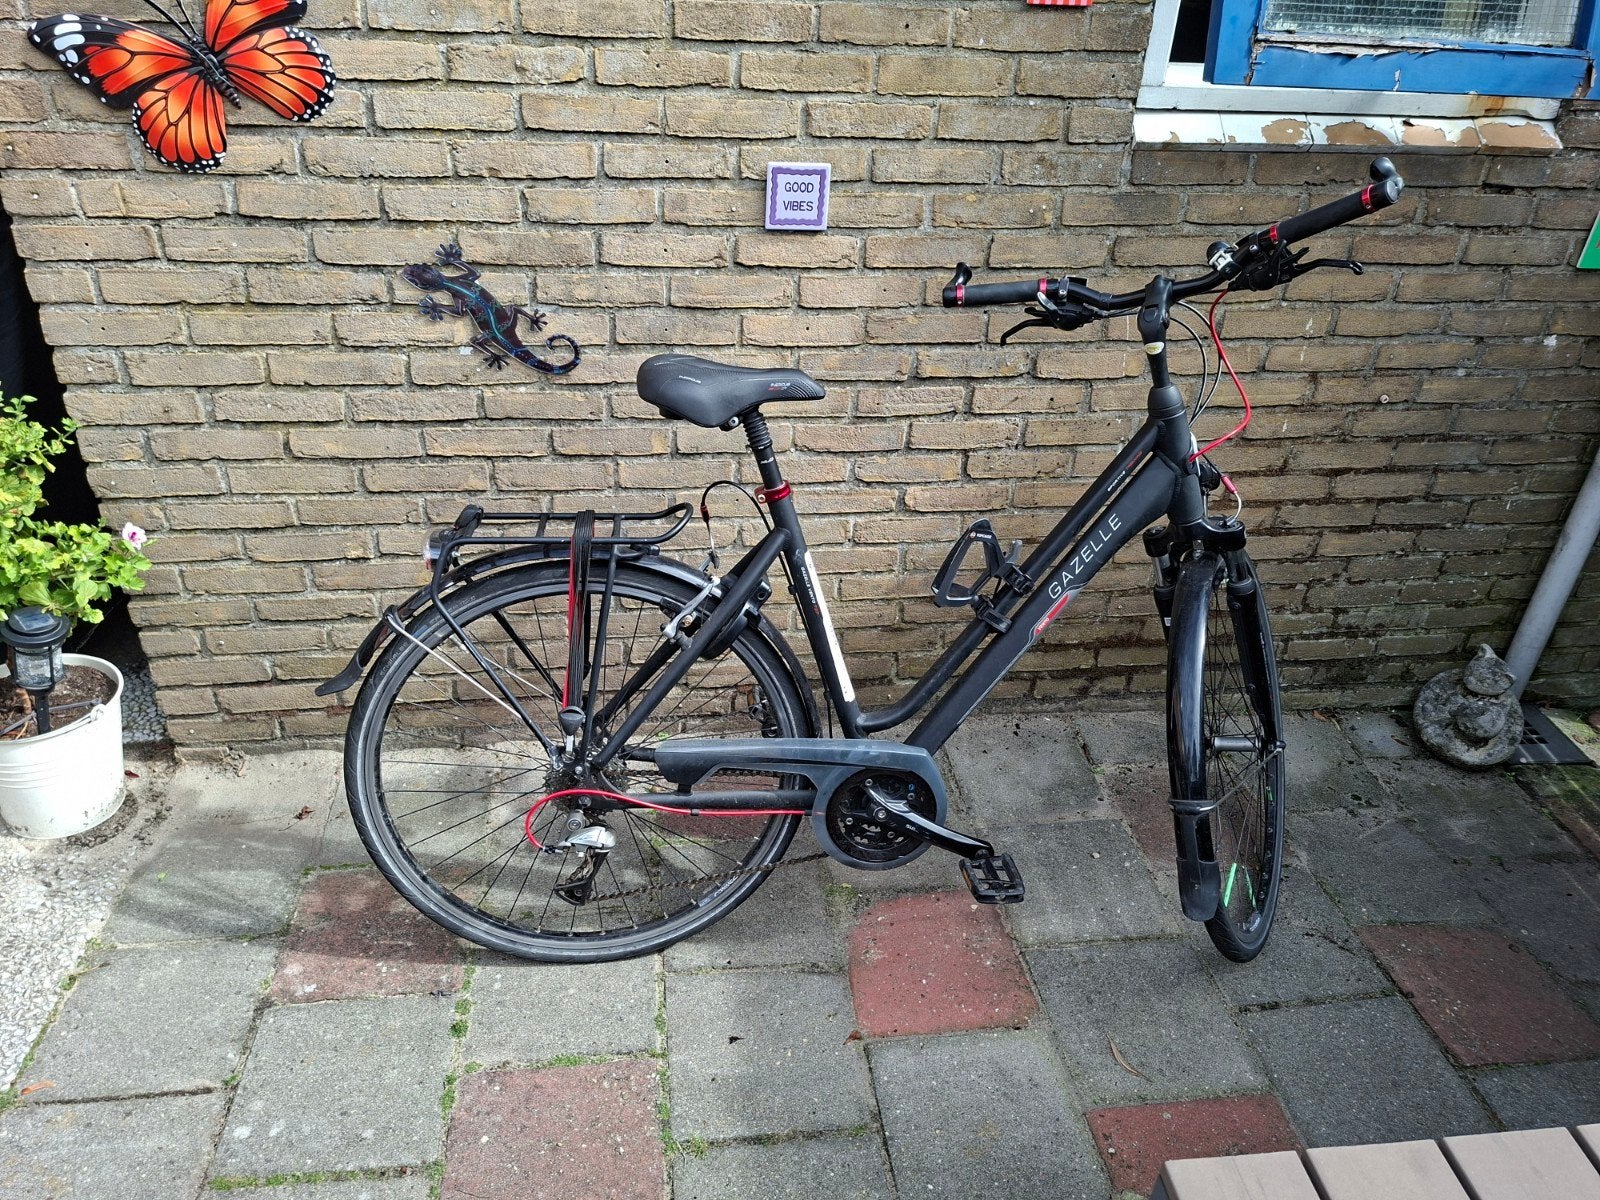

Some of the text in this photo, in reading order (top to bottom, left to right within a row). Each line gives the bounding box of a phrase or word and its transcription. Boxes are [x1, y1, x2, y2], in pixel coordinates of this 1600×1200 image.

[785, 182, 814, 193] GOOD
[783, 200, 814, 211] VIBES
[1048, 513, 1122, 599] GAZELLE
[800, 566, 810, 587] GAZELLE
[807, 587, 816, 604] VENTO
